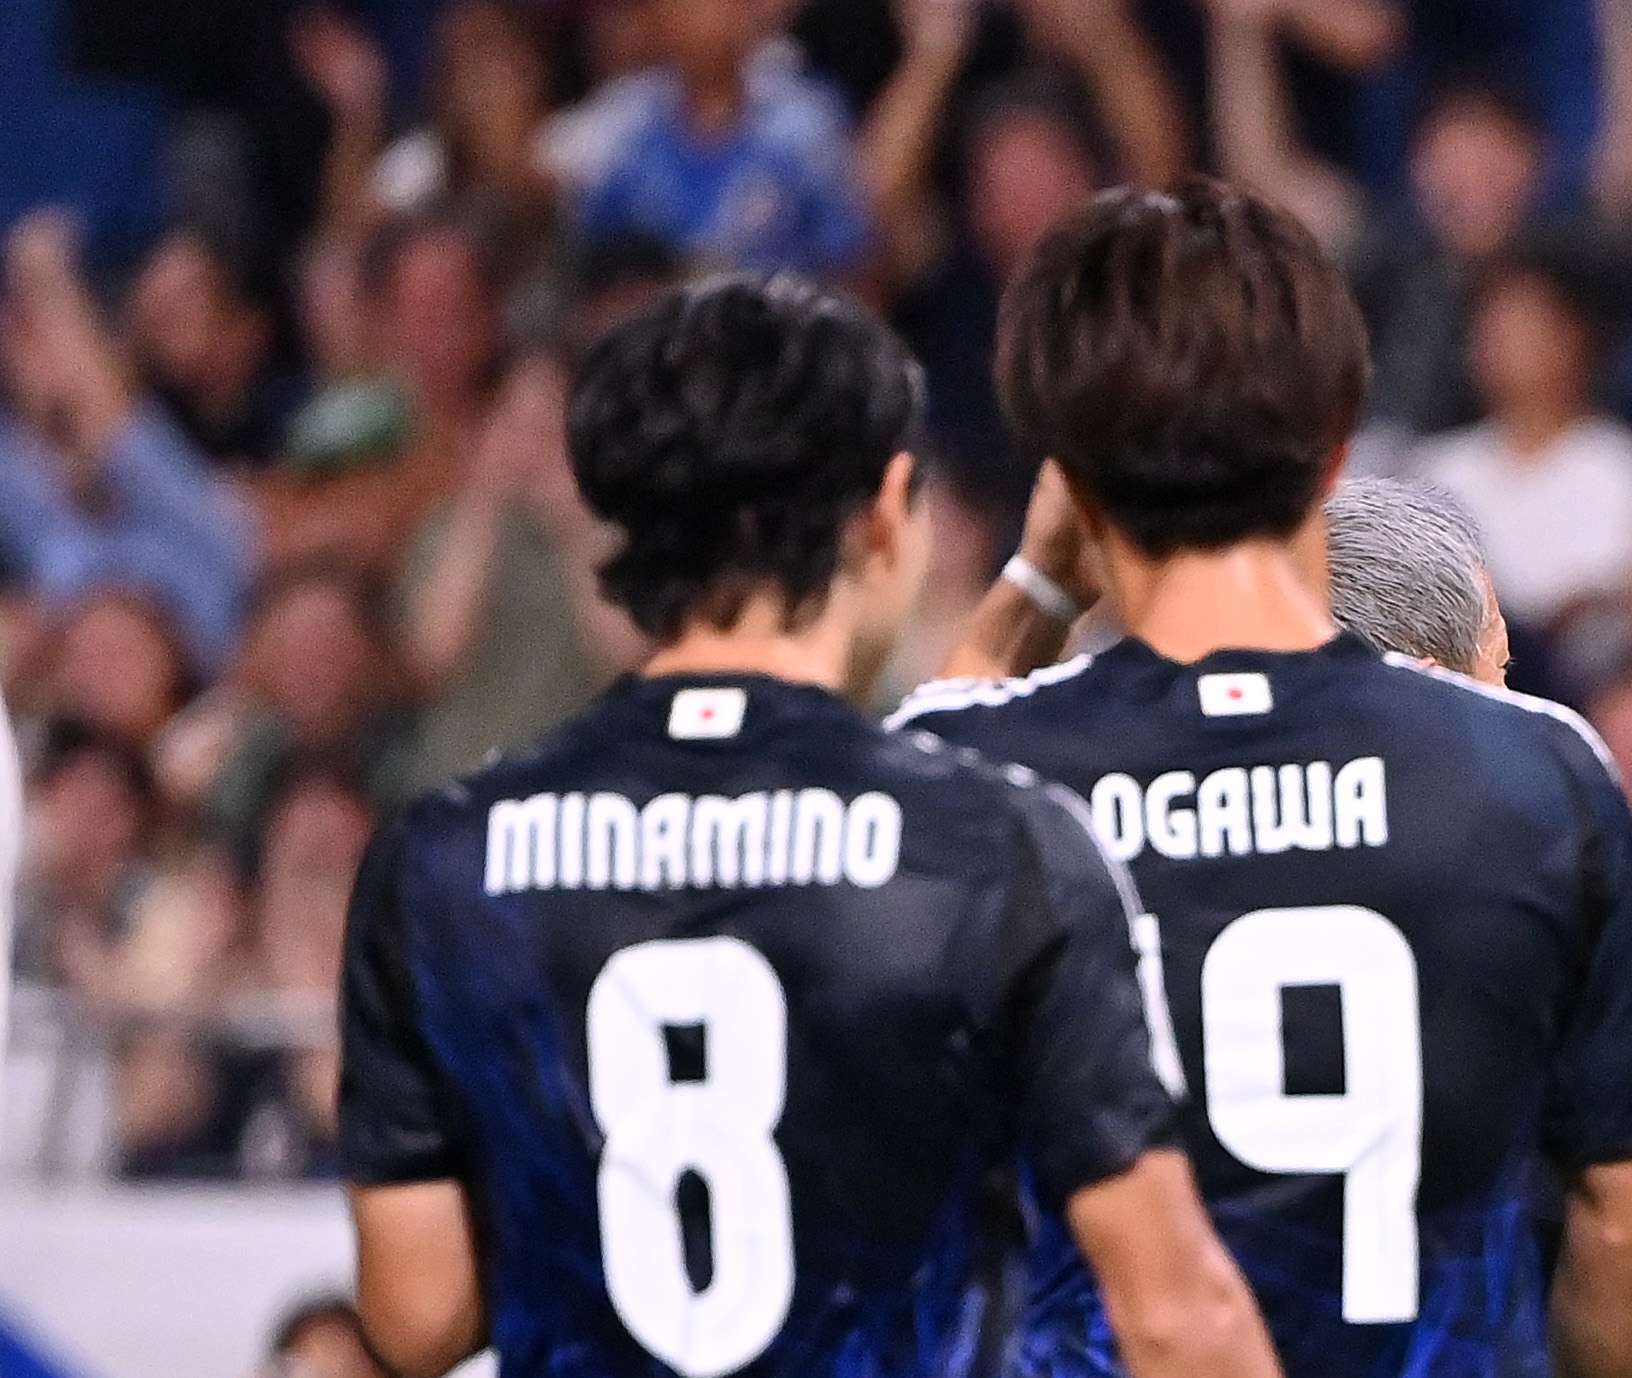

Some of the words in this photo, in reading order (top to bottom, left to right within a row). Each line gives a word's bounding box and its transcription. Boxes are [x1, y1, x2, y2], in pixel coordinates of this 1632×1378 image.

[484, 786, 901, 898] MINAMINO
[1090, 756, 1388, 862] OGAWA
[1130, 904, 1423, 1323] 9
